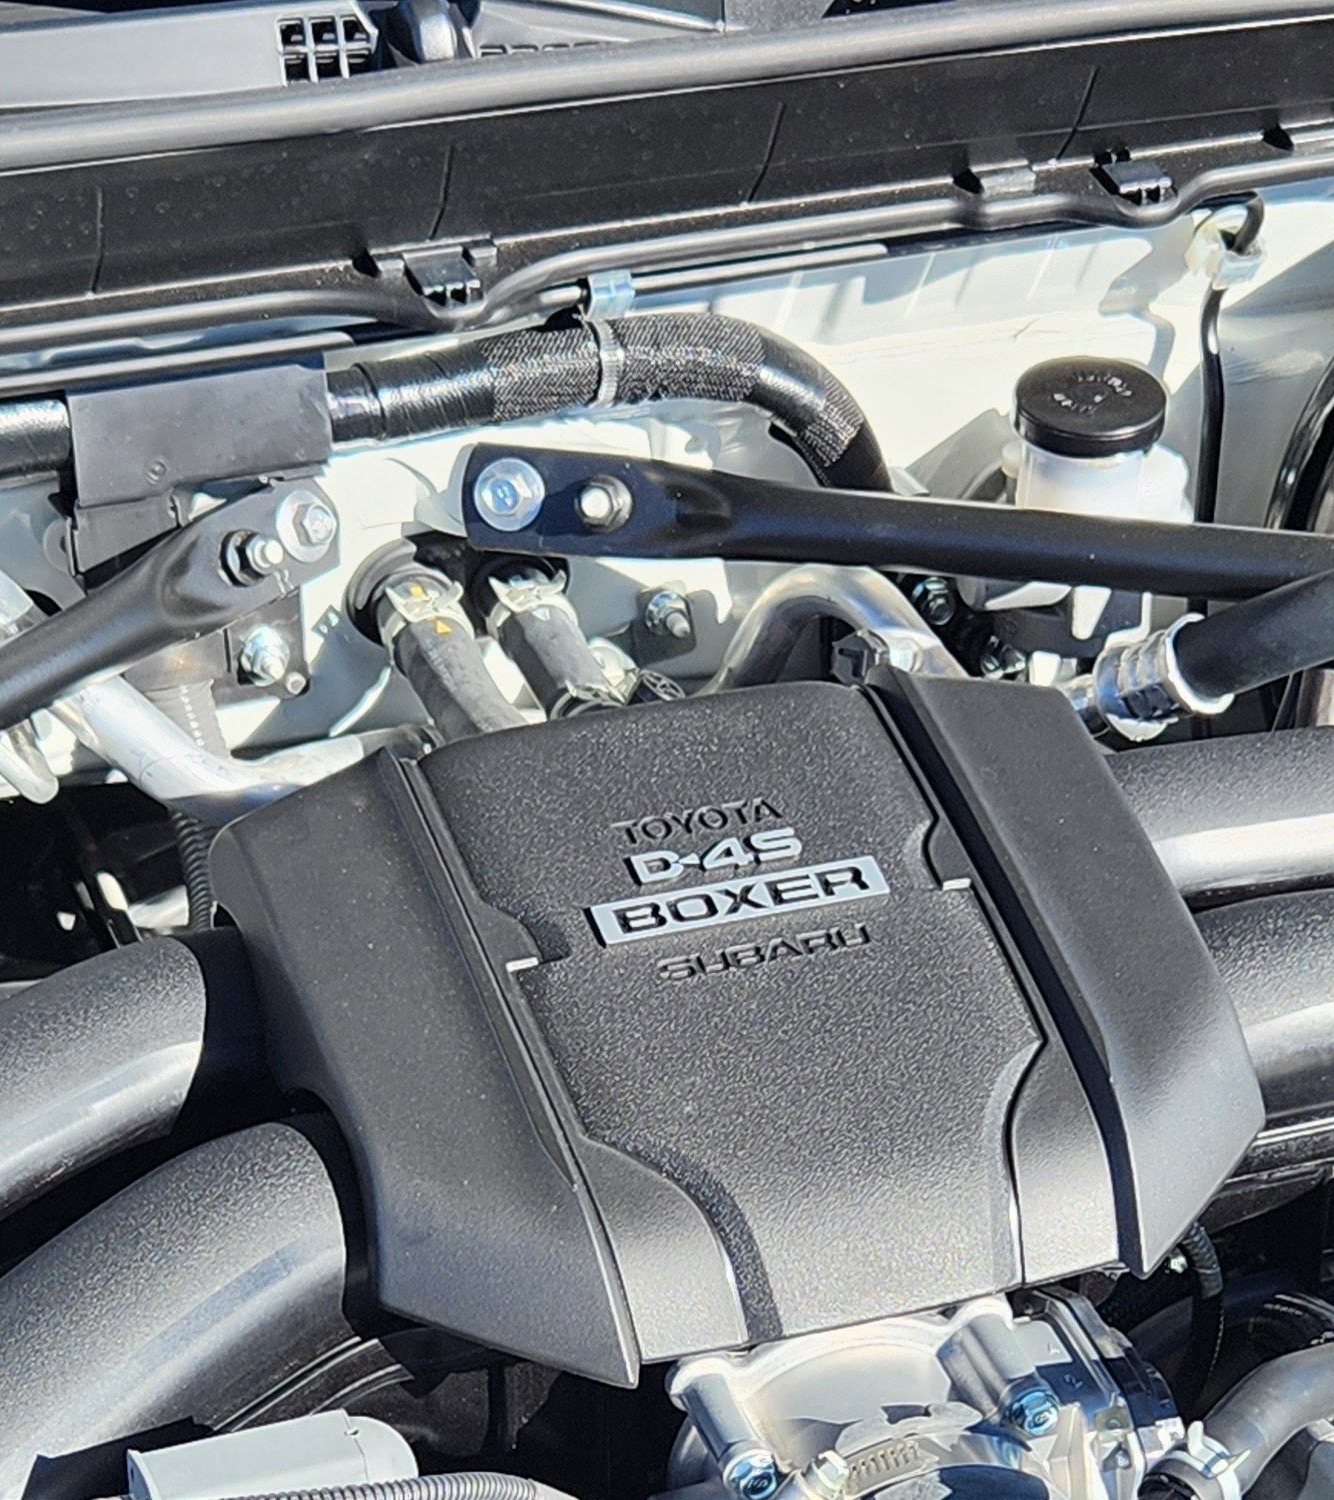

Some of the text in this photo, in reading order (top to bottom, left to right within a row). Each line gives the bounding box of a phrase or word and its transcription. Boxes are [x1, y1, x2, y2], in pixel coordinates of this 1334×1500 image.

[612, 798, 783, 845] TOYOTA
[612, 865, 871, 935] BOXER
[656, 923, 872, 982] SUBARU
